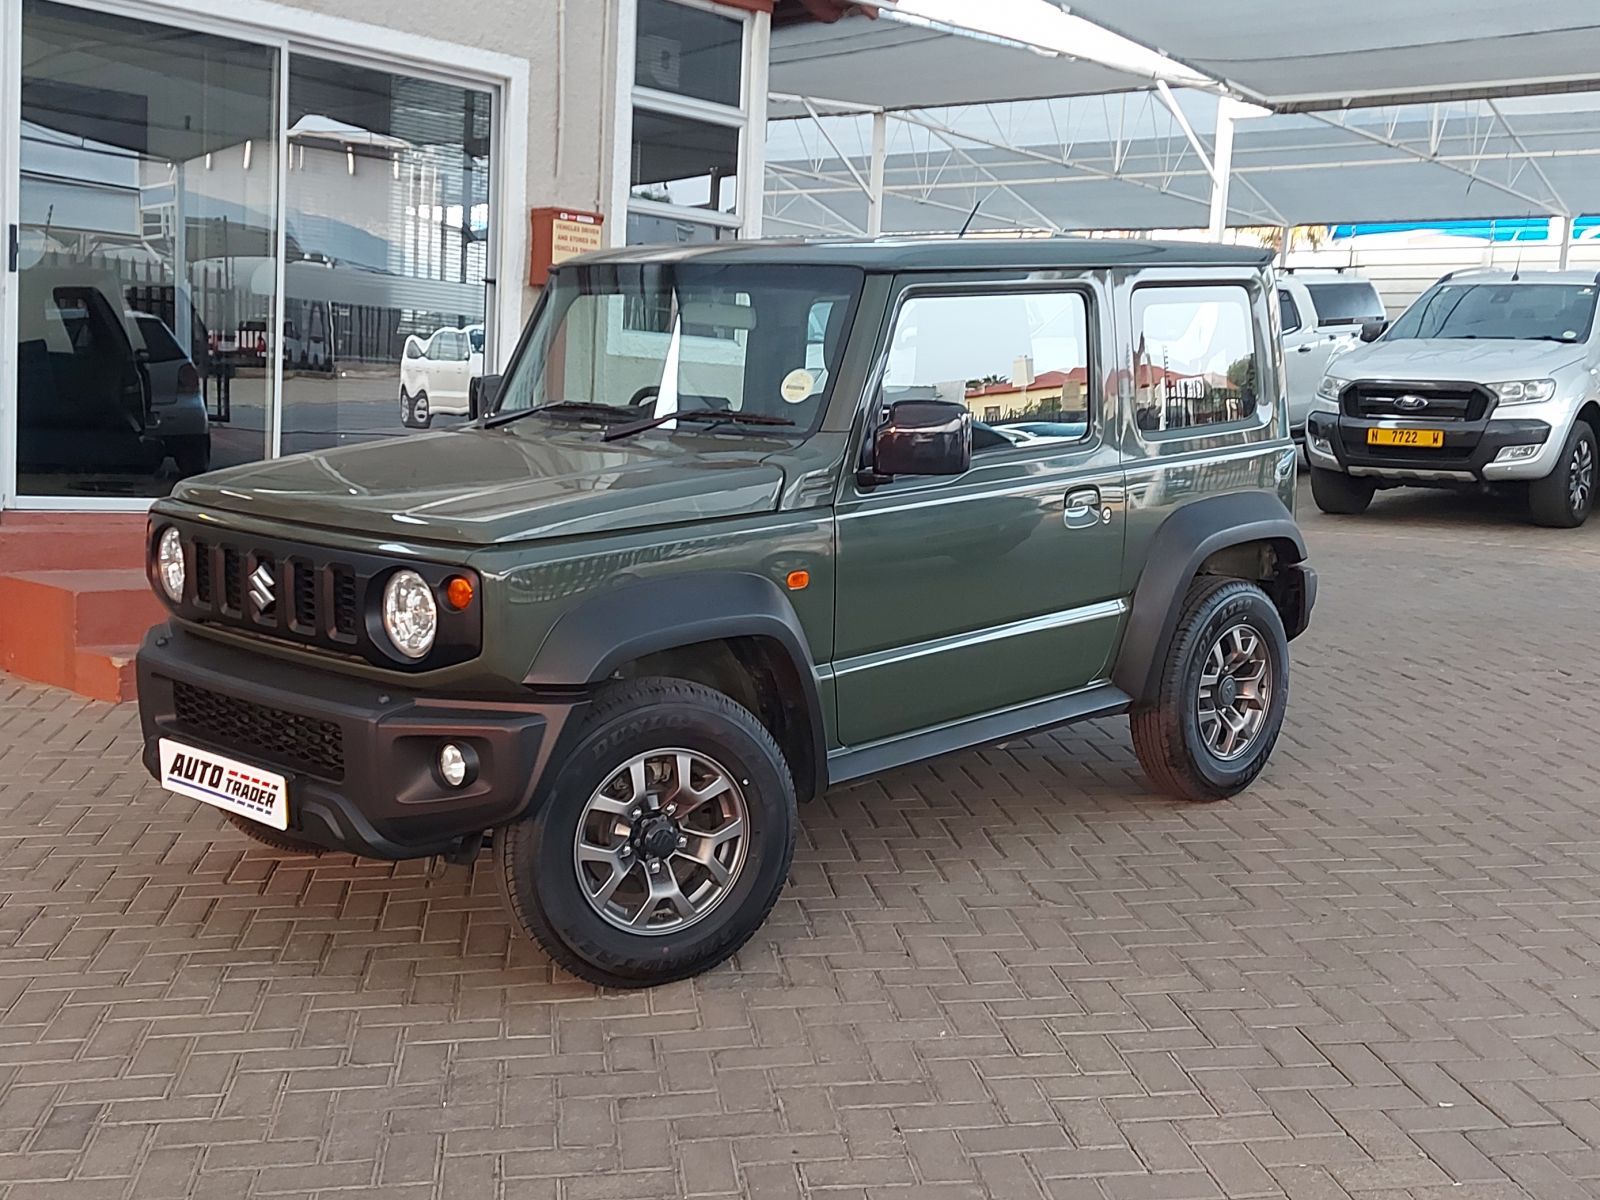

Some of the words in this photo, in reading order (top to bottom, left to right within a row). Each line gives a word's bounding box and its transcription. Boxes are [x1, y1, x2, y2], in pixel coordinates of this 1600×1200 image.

[556, 224, 580, 232] VEHICLES
[1371, 429, 1379, 442] N
[1392, 430, 1418, 443] 7722
[1432, 432, 1439, 445] W
[169, 753, 224, 789] AUTO
[225, 777, 276, 808] TRADER
